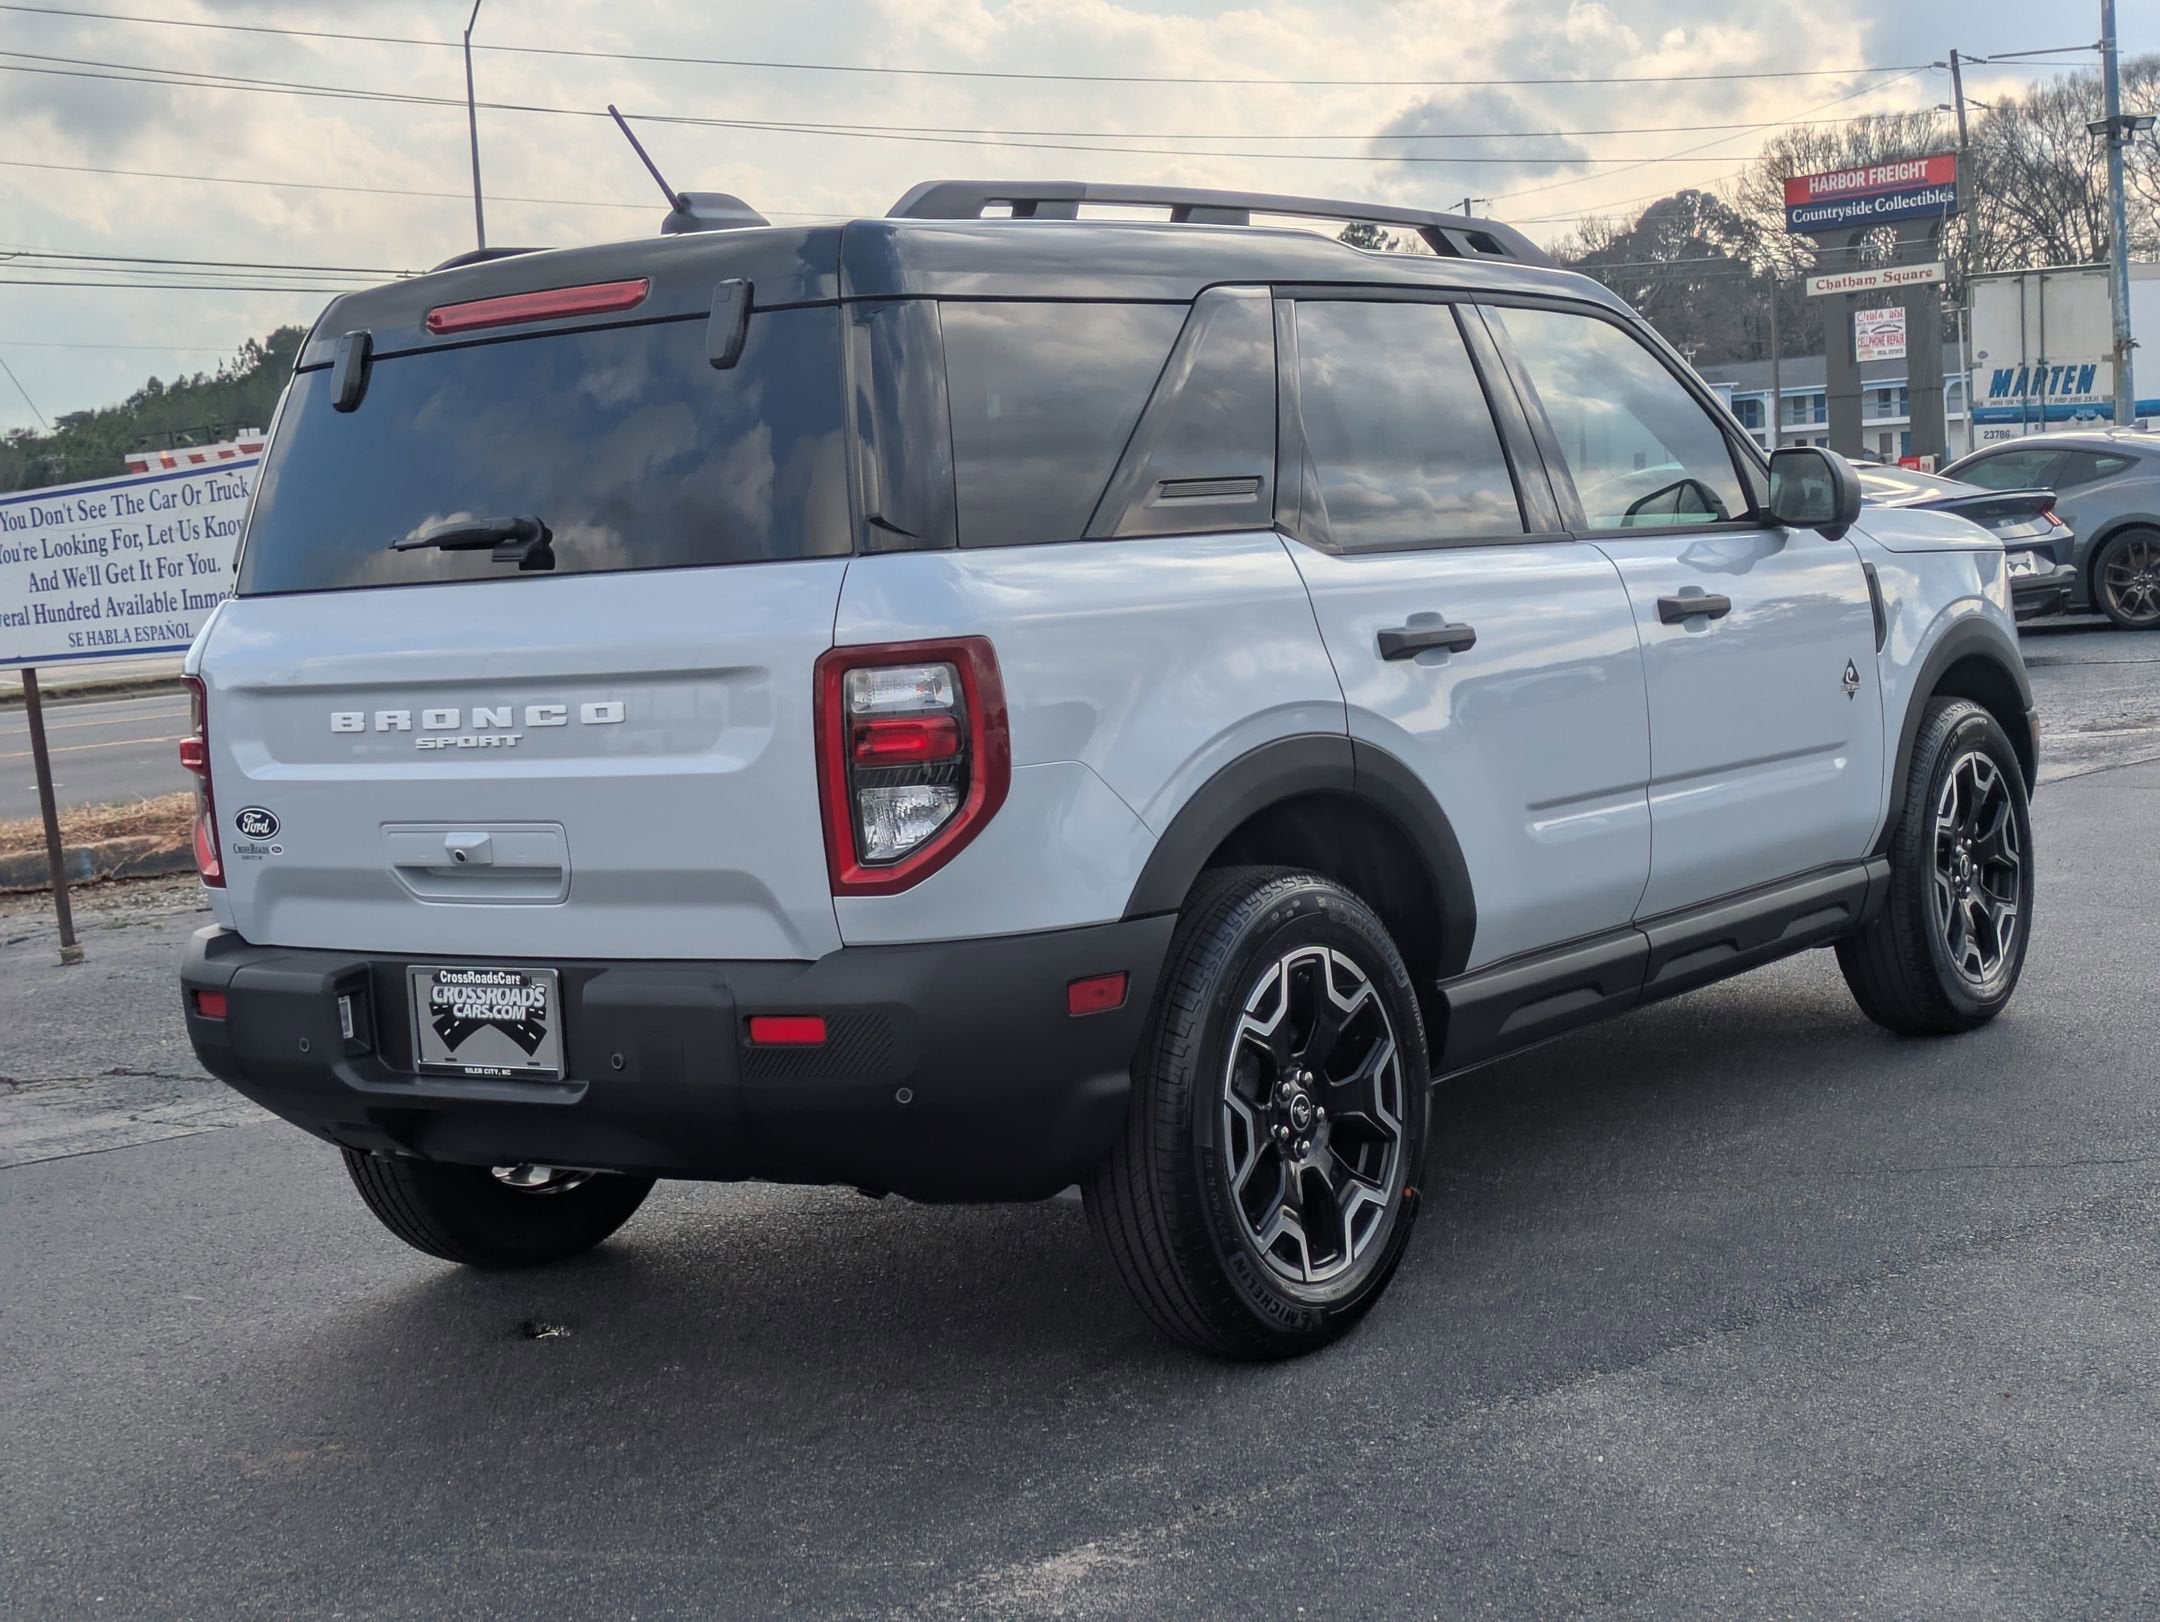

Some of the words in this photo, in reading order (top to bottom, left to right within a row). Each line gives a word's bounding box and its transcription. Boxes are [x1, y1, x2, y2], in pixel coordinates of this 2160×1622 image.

[1809, 171, 1865, 193] HARBOR
[1869, 161, 1928, 185] FREIGHT
[1792, 202, 1872, 222] Countryside
[1875, 189, 1954, 212] Collectibles
[1816, 276, 1877, 291] Chatham
[1883, 268, 1933, 284] Square
[1989, 364, 2096, 398] MARTEN
[0, 511, 27, 532] You
[29, 502, 74, 528] Don't
[77, 499, 107, 521] See
[110, 493, 145, 517] The
[149, 488, 178, 511] Car
[182, 483, 202, 506] Or
[205, 475, 250, 503] Truck
[40, 533, 108, 558] Looking
[111, 528, 144, 552] For,
[146, 523, 175, 546] Let
[177, 519, 200, 542] Us
[29, 569, 60, 593] And
[62, 564, 102, 589] We'll
[105, 562, 135, 584] Get
[139, 559, 153, 581] It
[156, 556, 184, 579] For
[187, 552, 221, 576] You.
[32, 597, 102, 625] Hundred
[106, 591, 178, 619] Available
[68, 632, 84, 648] SE
[87, 627, 132, 647] HABLA
[134, 620, 194, 642] ESPAÑOL
[331, 701, 625, 733] BRONCO
[415, 734, 522, 750] SPORT
[242, 812, 270, 833] Ford
[432, 985, 546, 1007] CROSSROADS
[453, 1003, 526, 1020] CARS.COM
[1232, 1257, 1300, 1326] MICHELIN
